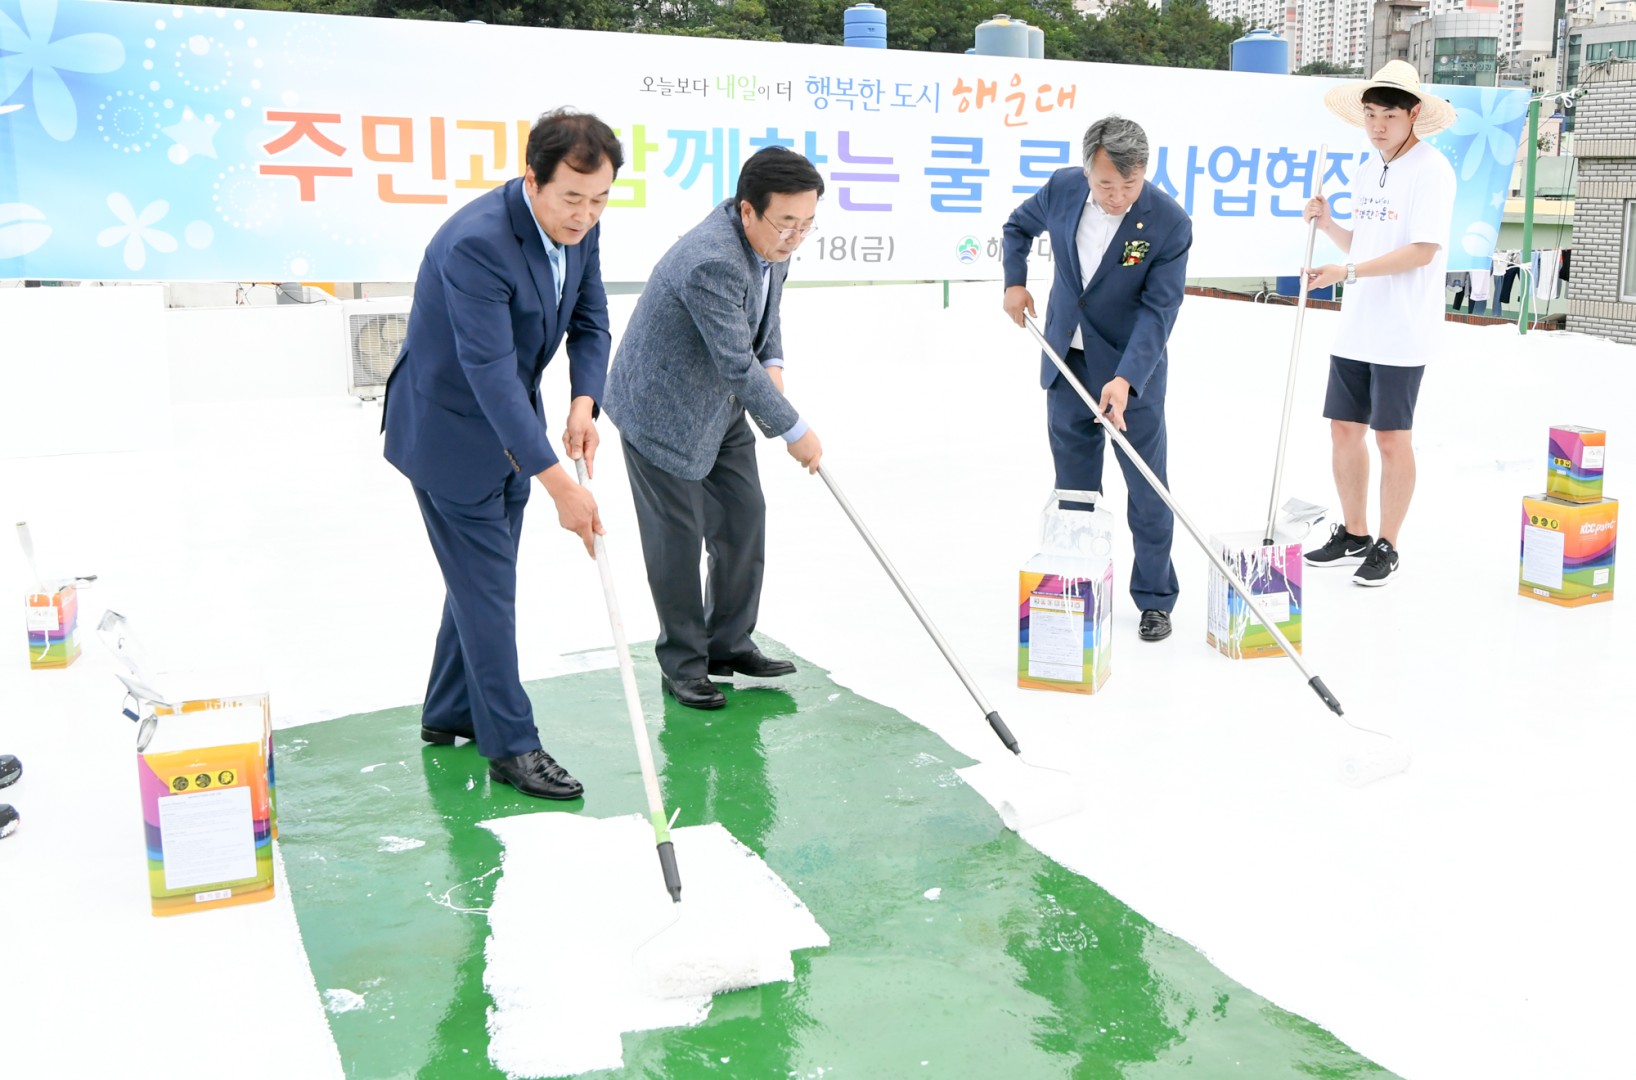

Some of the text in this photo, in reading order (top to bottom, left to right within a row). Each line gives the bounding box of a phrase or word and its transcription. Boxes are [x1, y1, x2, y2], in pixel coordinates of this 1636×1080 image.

[639, 73, 1077, 127] 오늘보다 내일이 더 행복한 도시 해운대
[259, 110, 532, 204] 주민과
[923, 135, 990, 213] 쿨
[816, 235, 895, 263] 18(금)
